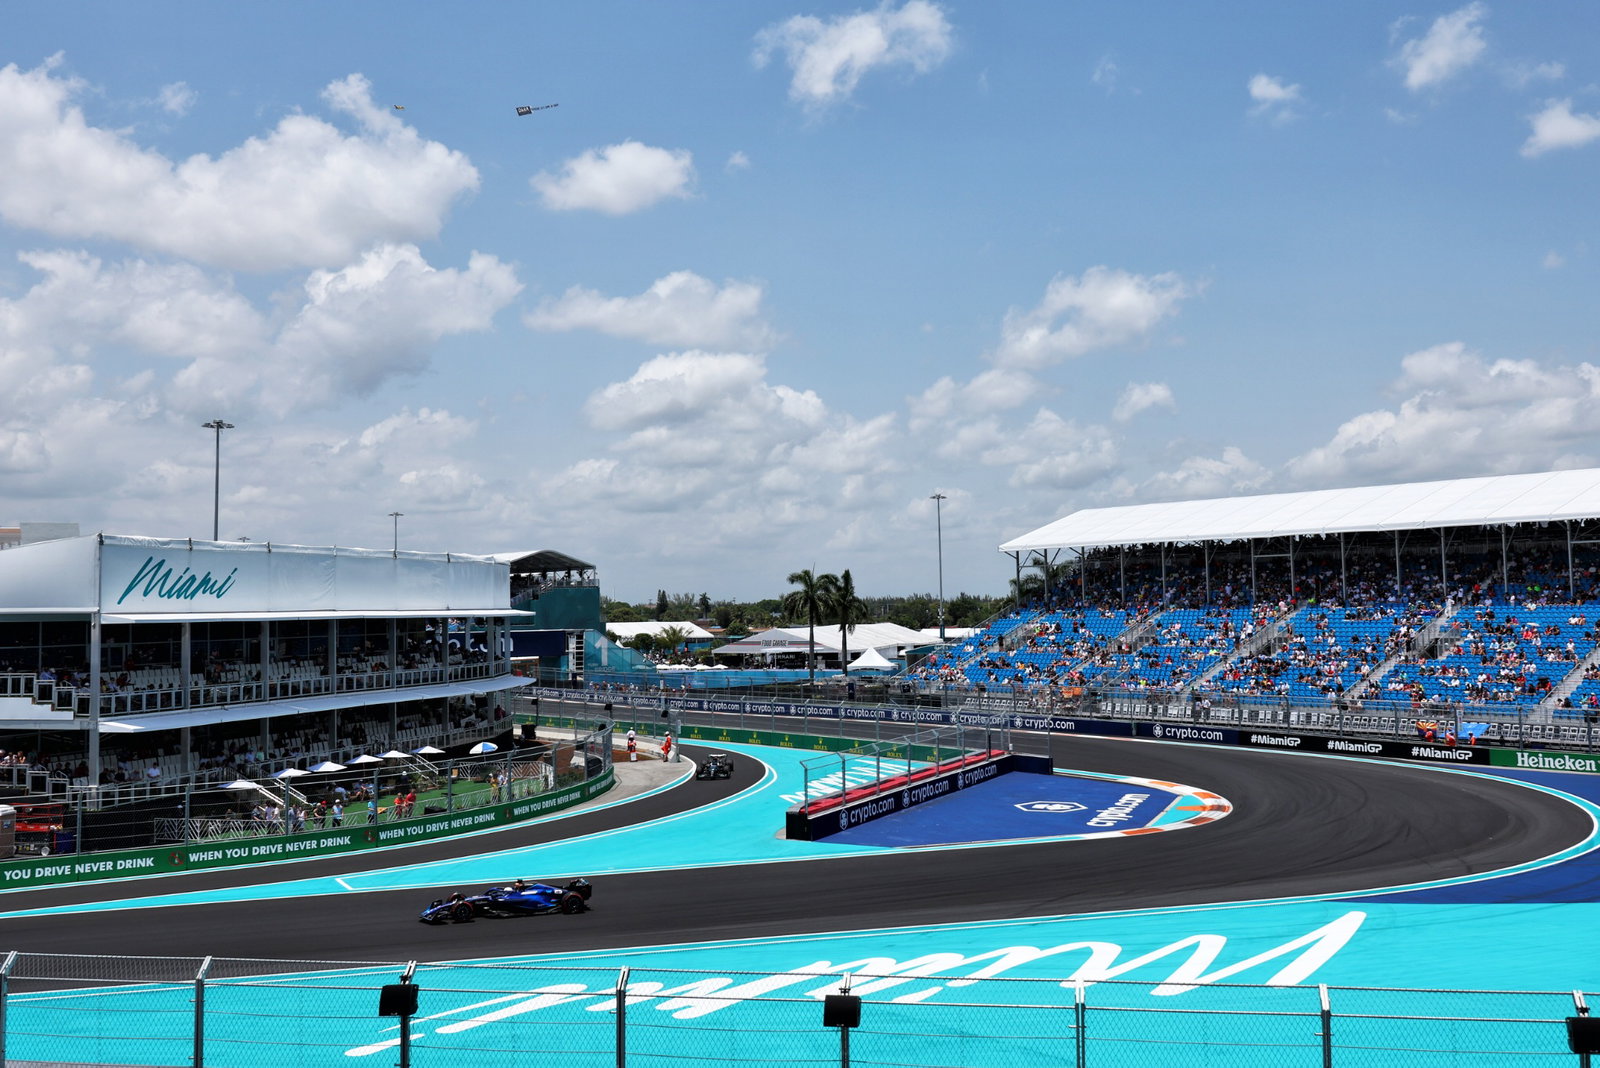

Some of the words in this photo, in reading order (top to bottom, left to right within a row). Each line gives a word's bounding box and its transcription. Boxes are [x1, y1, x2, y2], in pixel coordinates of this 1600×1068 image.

[117, 556, 238, 605] Miami
[1165, 726, 1223, 741] crypto.com
[1250, 734, 1301, 747] #MiamiGP
[1327, 740, 1382, 754] #MiamiGP
[1411, 746, 1473, 761] #MiamiGP
[1516, 752, 1597, 772] Heineken
[964, 763, 997, 785] crypto.com
[911, 779, 949, 802] crypto.com
[513, 804, 530, 816] WHEN
[530, 802, 542, 812] YOU
[542, 798, 557, 809] DRIVE
[850, 797, 895, 823] crypto.com
[1086, 793, 1151, 827] crypto.com
[378, 828, 405, 840] WHEN
[406, 823, 424, 836] YOU
[426, 821, 449, 833] DRIVE
[451, 816, 473, 829] NEVER
[474, 812, 496, 824] DRINK
[188, 851, 223, 863] WHEN
[225, 847, 249, 858] YOU
[252, 844, 284, 856] DRIVE
[285, 840, 317, 852] NEVER
[320, 836, 351, 848] DRINK
[4, 868, 31, 881] YOU
[34, 865, 72, 878] DRIVE
[75, 861, 114, 874] NEVER
[116, 857, 155, 870] DRINK
[345, 911, 1367, 1058] Miami
